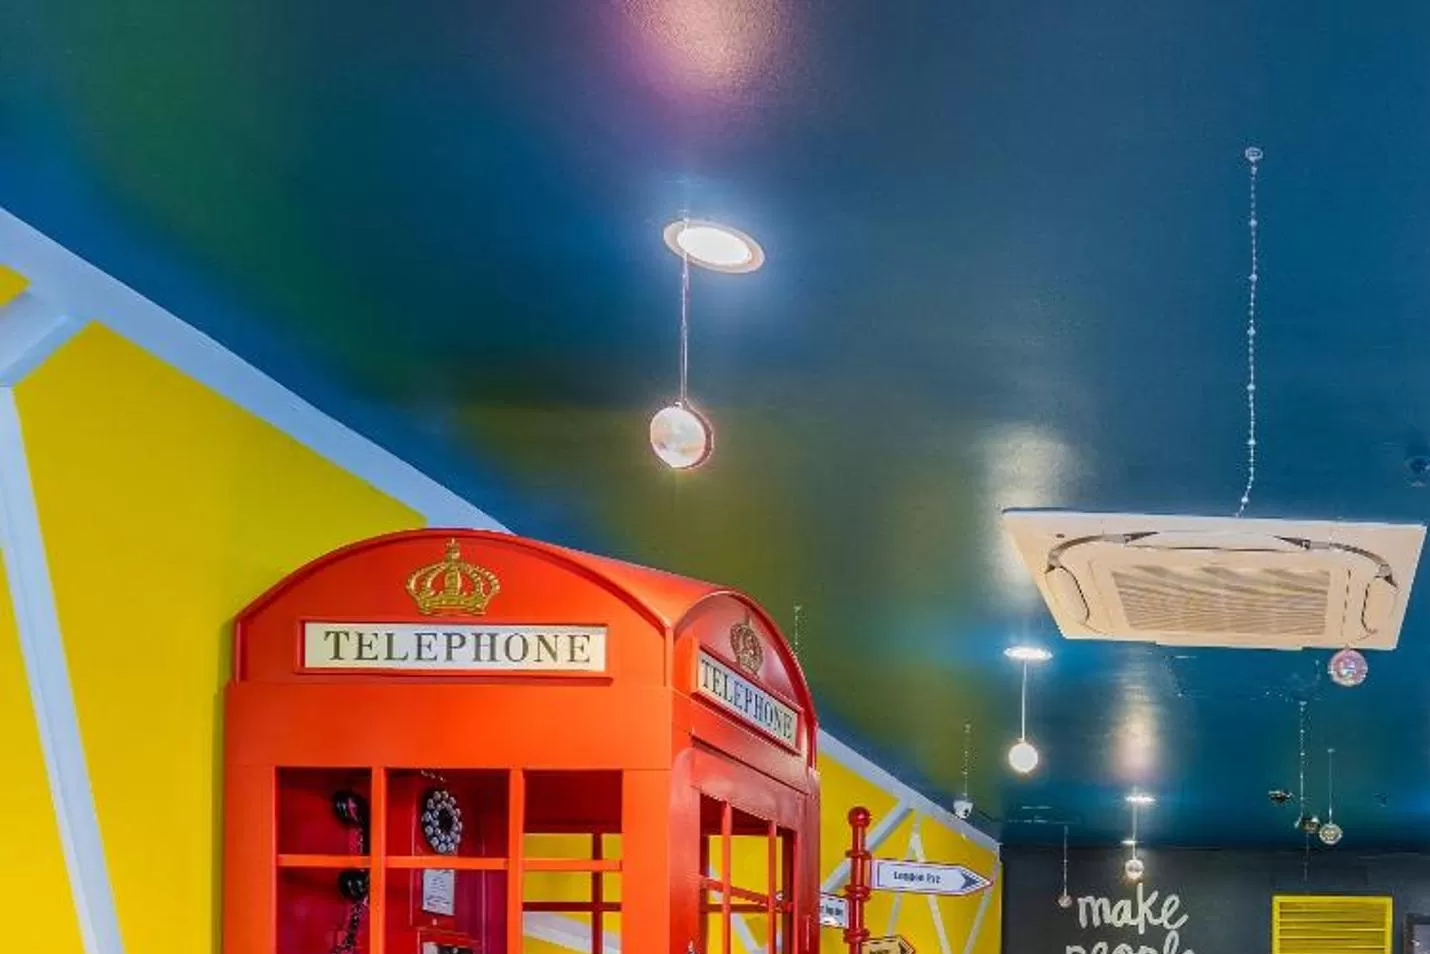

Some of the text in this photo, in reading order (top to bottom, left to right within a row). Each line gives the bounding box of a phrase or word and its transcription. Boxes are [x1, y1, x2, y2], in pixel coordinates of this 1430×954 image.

[323, 630, 591, 664] TELEPHONE
[701, 659, 793, 740] TELEPHONE
[1077, 882, 1189, 935] make
